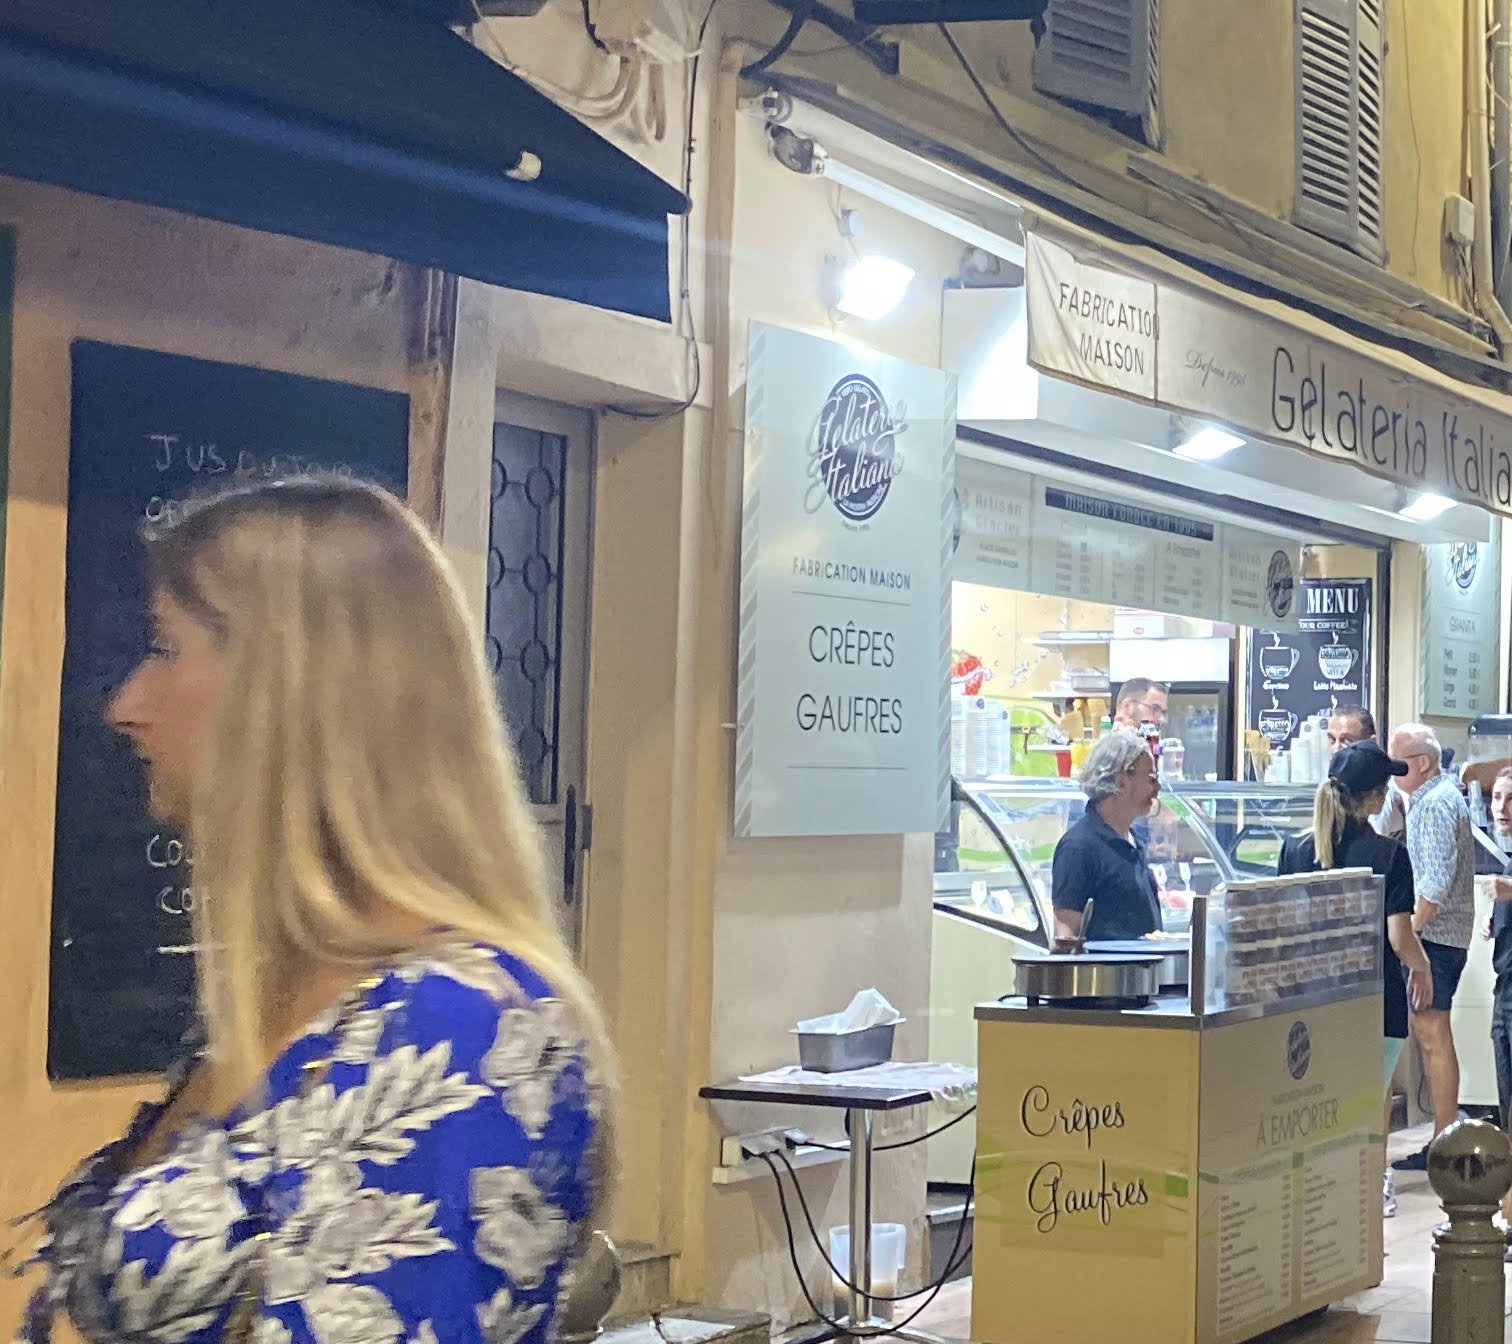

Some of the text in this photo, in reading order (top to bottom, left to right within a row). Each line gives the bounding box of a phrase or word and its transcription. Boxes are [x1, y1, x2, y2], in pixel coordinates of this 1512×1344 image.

[1059, 282, 1160, 340] FABRICATION
[1080, 333, 1144, 375] MAISON
[1272, 346, 1427, 480] Gelateria
[792, 557, 911, 590] FABRICATION MAISON
[1306, 587, 1359, 614] MENU
[809, 620, 895, 668] CRÊPES
[796, 693, 903, 734] GAUFRES
[1022, 1085, 1125, 1149] Crêpes
[1271, 1097, 1339, 1146] EMPORTER
[1028, 1158, 1148, 1233] Gaufres
